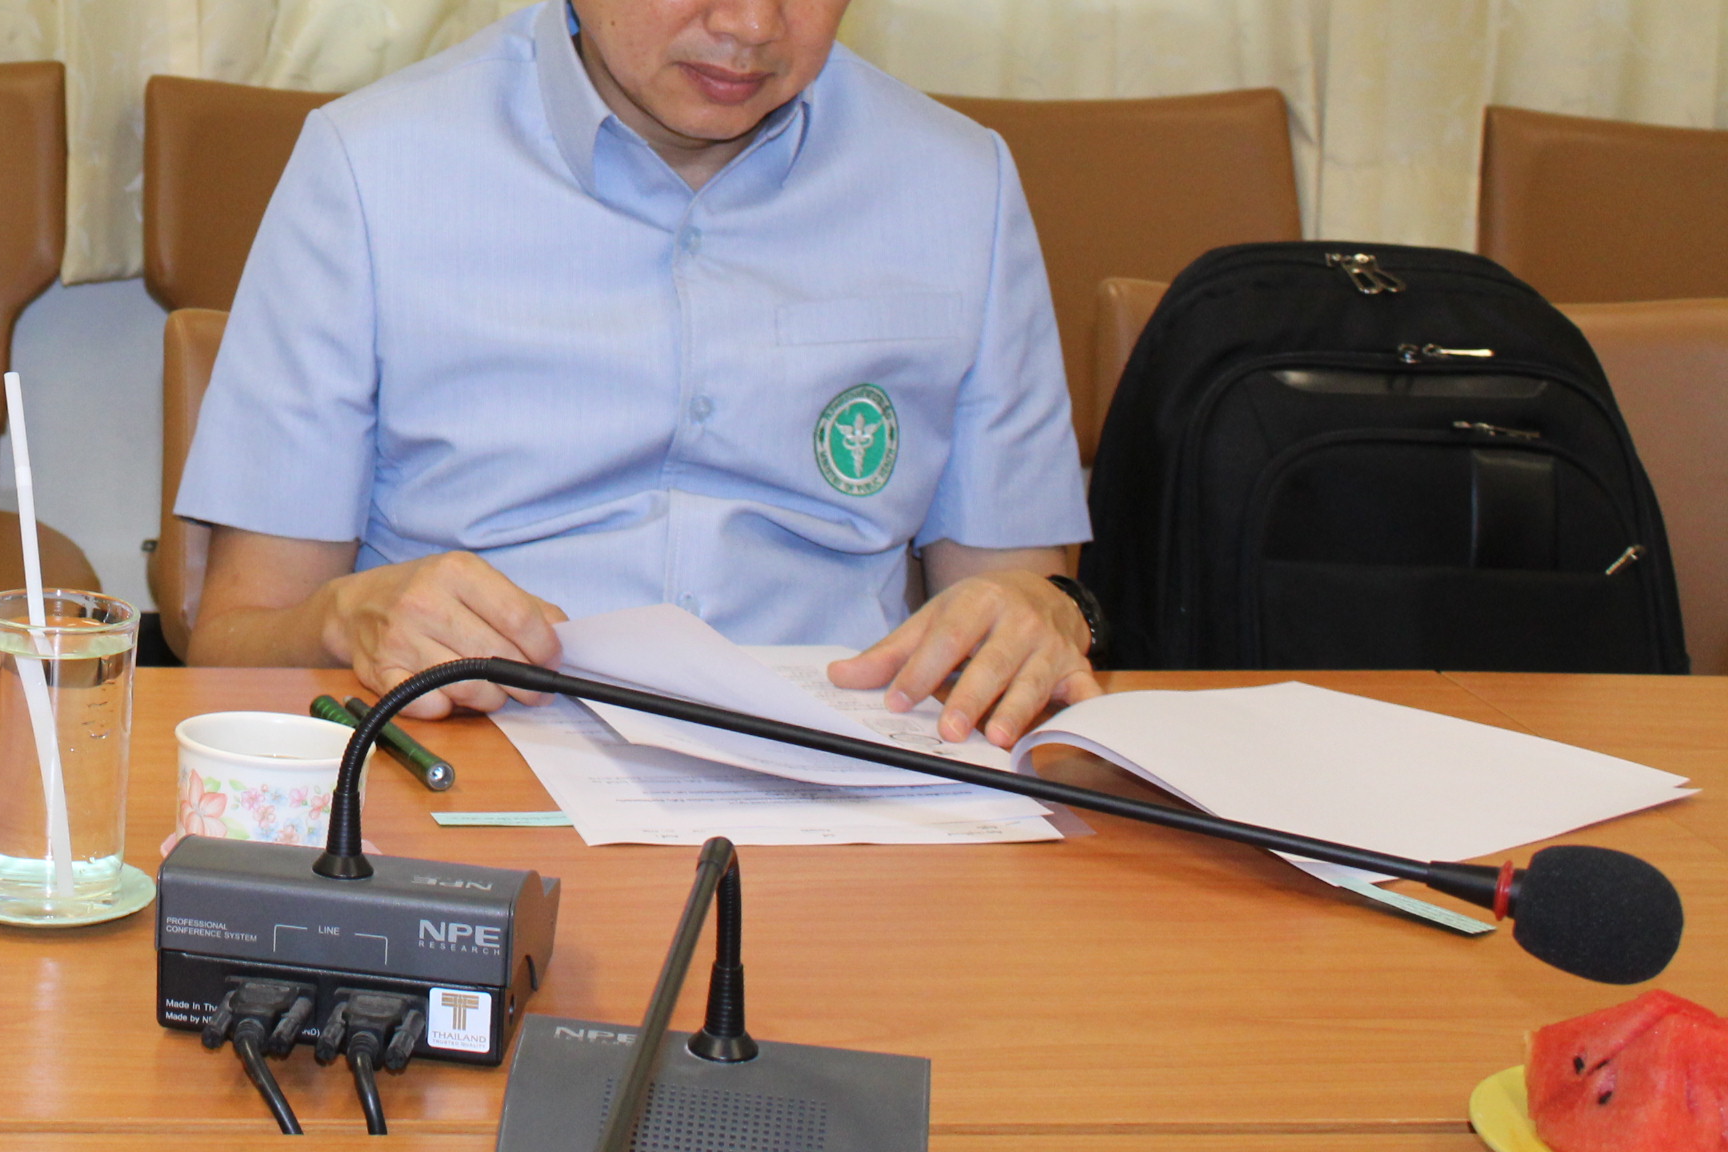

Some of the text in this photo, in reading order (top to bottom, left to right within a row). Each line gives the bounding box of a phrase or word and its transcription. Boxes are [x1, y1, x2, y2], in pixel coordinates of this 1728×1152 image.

[166, 917, 228, 930] PROFESSIONAL
[166, 926, 257, 942] CONFERENCE SYSTEM
[318, 925, 340, 936] LINE
[419, 919, 501, 948] NPE
[418, 940, 500, 956] RESEARCH
[165, 999, 190, 1009] Made
[165, 1011, 187, 1021] Made
[190, 1014, 199, 1024] by
[432, 1031, 487, 1043] THAILAND
[554, 1026, 639, 1043] NPE
